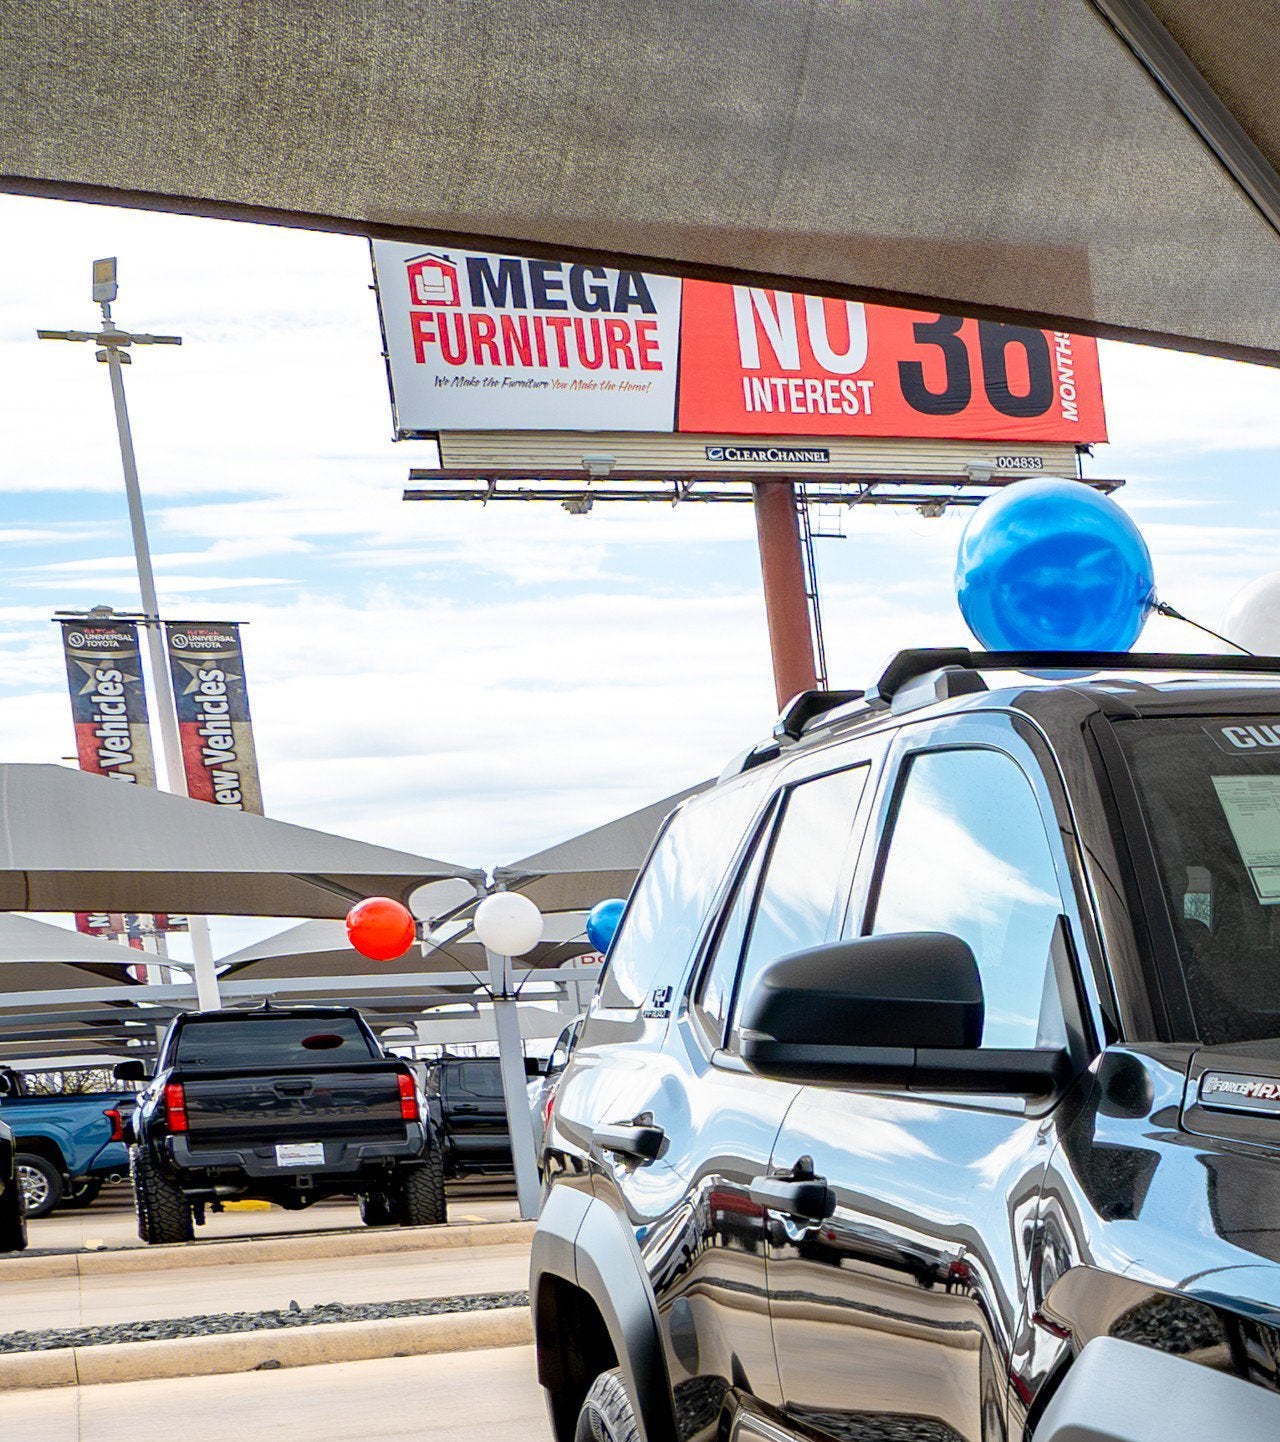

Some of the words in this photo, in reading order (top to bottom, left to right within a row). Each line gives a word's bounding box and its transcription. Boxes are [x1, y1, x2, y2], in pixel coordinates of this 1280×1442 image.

[466, 257, 658, 315] MEGA
[410, 311, 663, 372] FURNITURE
[731, 284, 869, 375] NO
[897, 313, 1055, 418] 36
[434, 375, 450, 387] We
[451, 376, 480, 388] Make
[482, 376, 500, 388] the
[501, 377, 549, 389] Furniture
[569, 379, 598, 391] Make
[599, 379, 616, 392] the
[742, 376, 874, 416] INTEREST
[85, 633, 134, 642] UNIVERSAL
[86, 640, 119, 648] TOYOTA
[188, 634, 237, 643] UNIVERSAL
[190, 641, 222, 649] TOYOTA
[91, 669, 134, 768] Vehicles
[195, 669, 237, 766] Vehicles
[211, 770, 244, 812] ew
